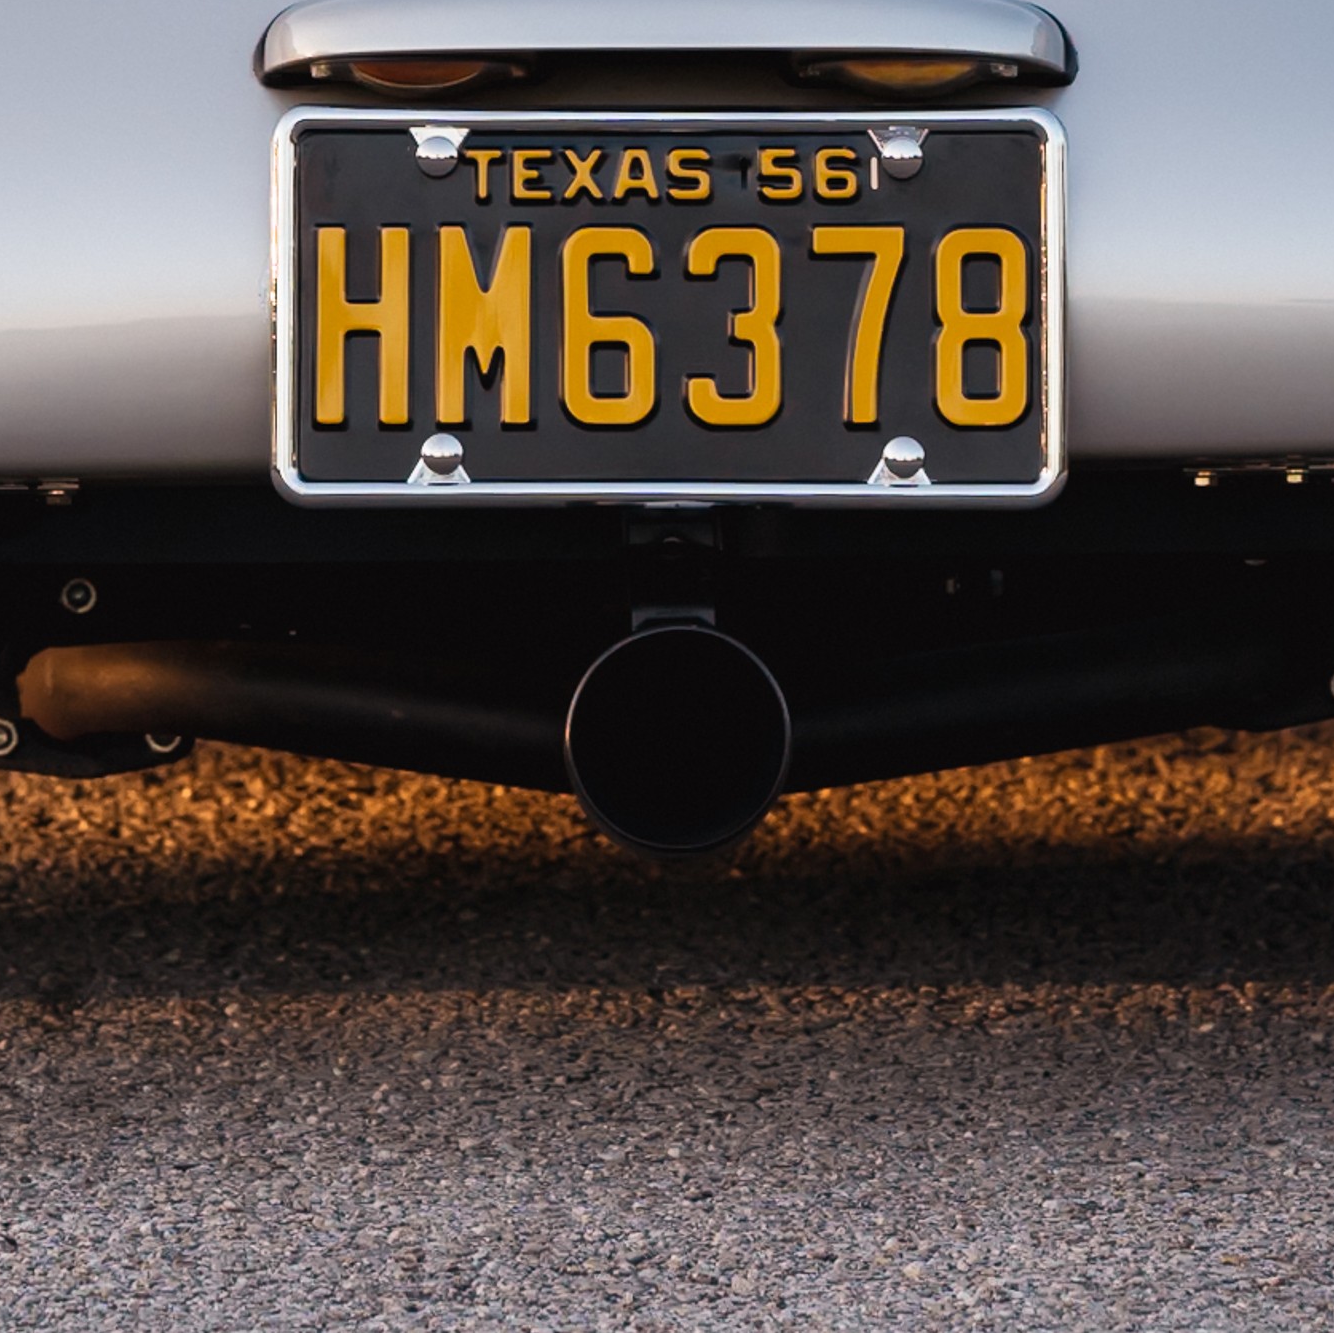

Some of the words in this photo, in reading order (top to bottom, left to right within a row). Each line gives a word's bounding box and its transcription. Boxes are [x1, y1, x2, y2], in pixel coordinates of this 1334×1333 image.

[463, 148, 711, 200] TEXAS
[758, 147, 859, 200] 56
[315, 225, 1029, 426] HM6378
